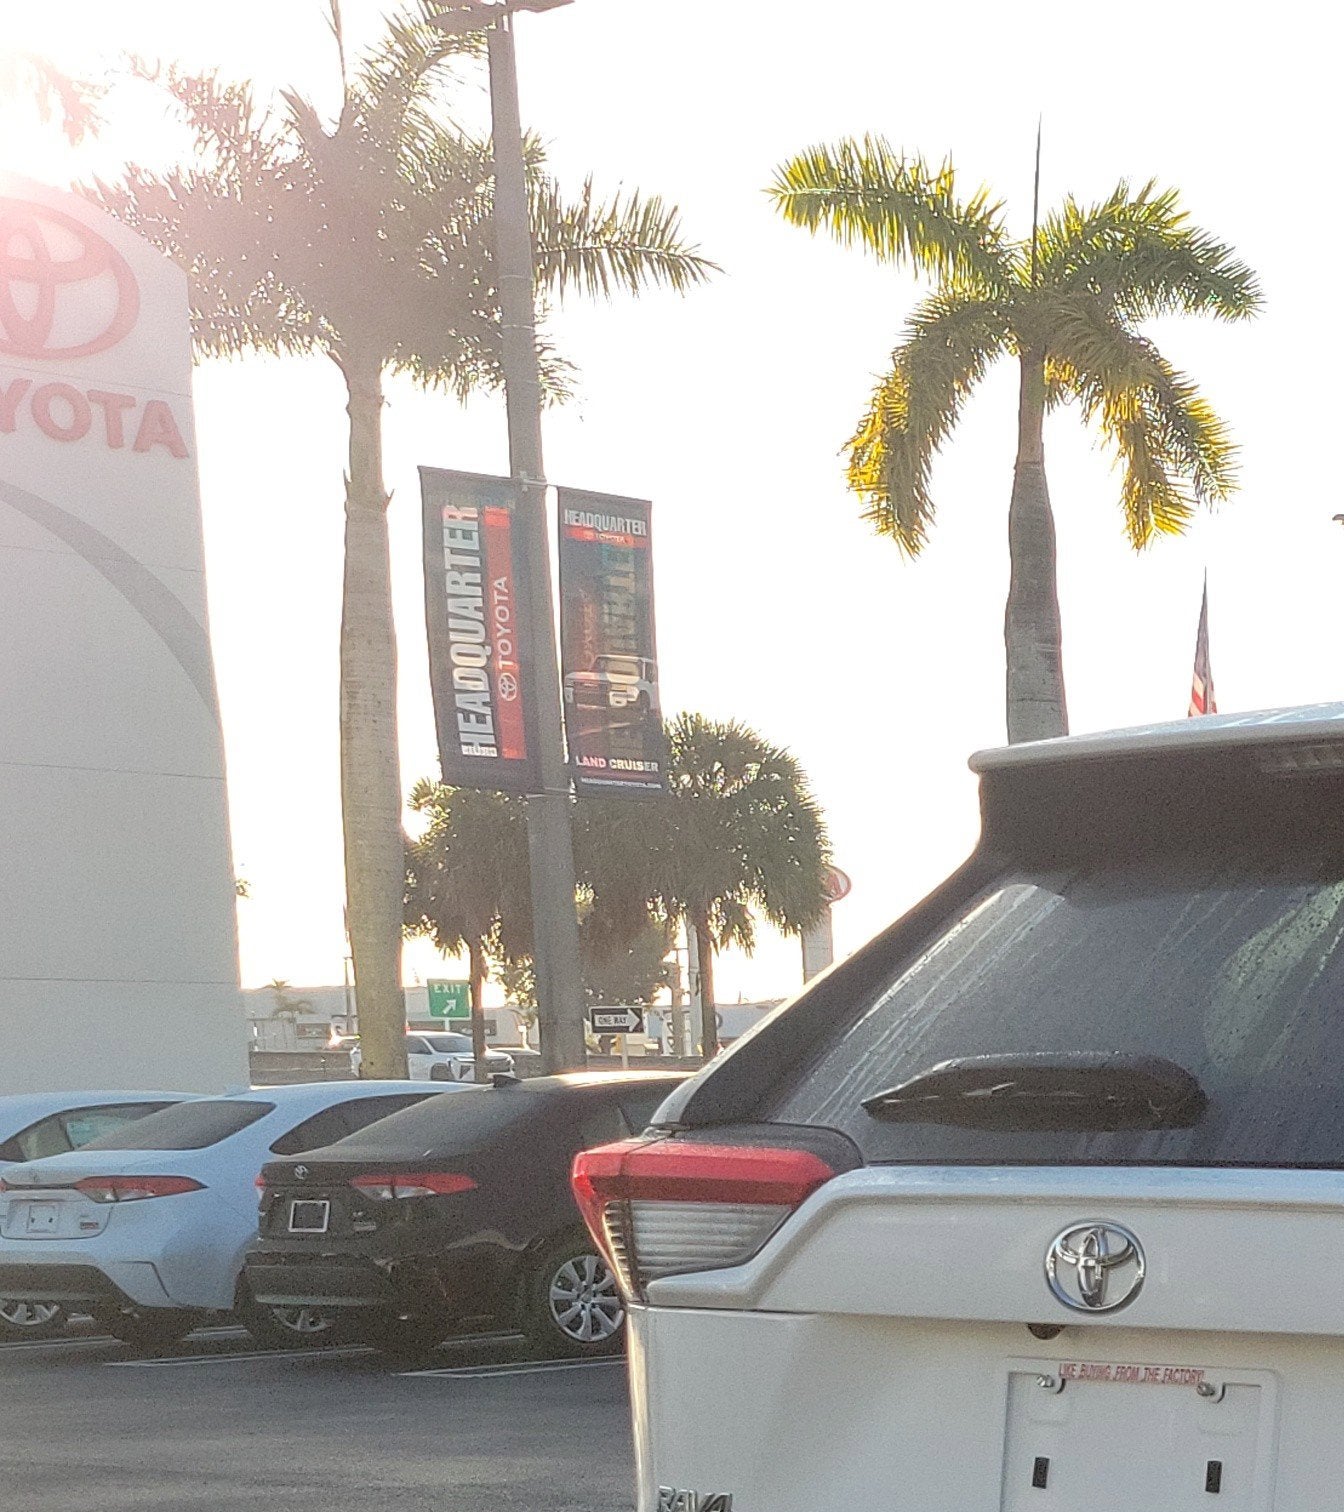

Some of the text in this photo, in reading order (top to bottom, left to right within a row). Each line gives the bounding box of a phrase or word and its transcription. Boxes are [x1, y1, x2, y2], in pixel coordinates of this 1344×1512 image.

[565, 508, 647, 536] HEADQUARTER
[442, 505, 498, 757] HEADQUARTER
[492, 576, 516, 669] TOYOTA
[575, 755, 659, 772] LAND CRUISER
[434, 984, 461, 994] EXIT
[598, 1015, 627, 1025] ONE WAY
